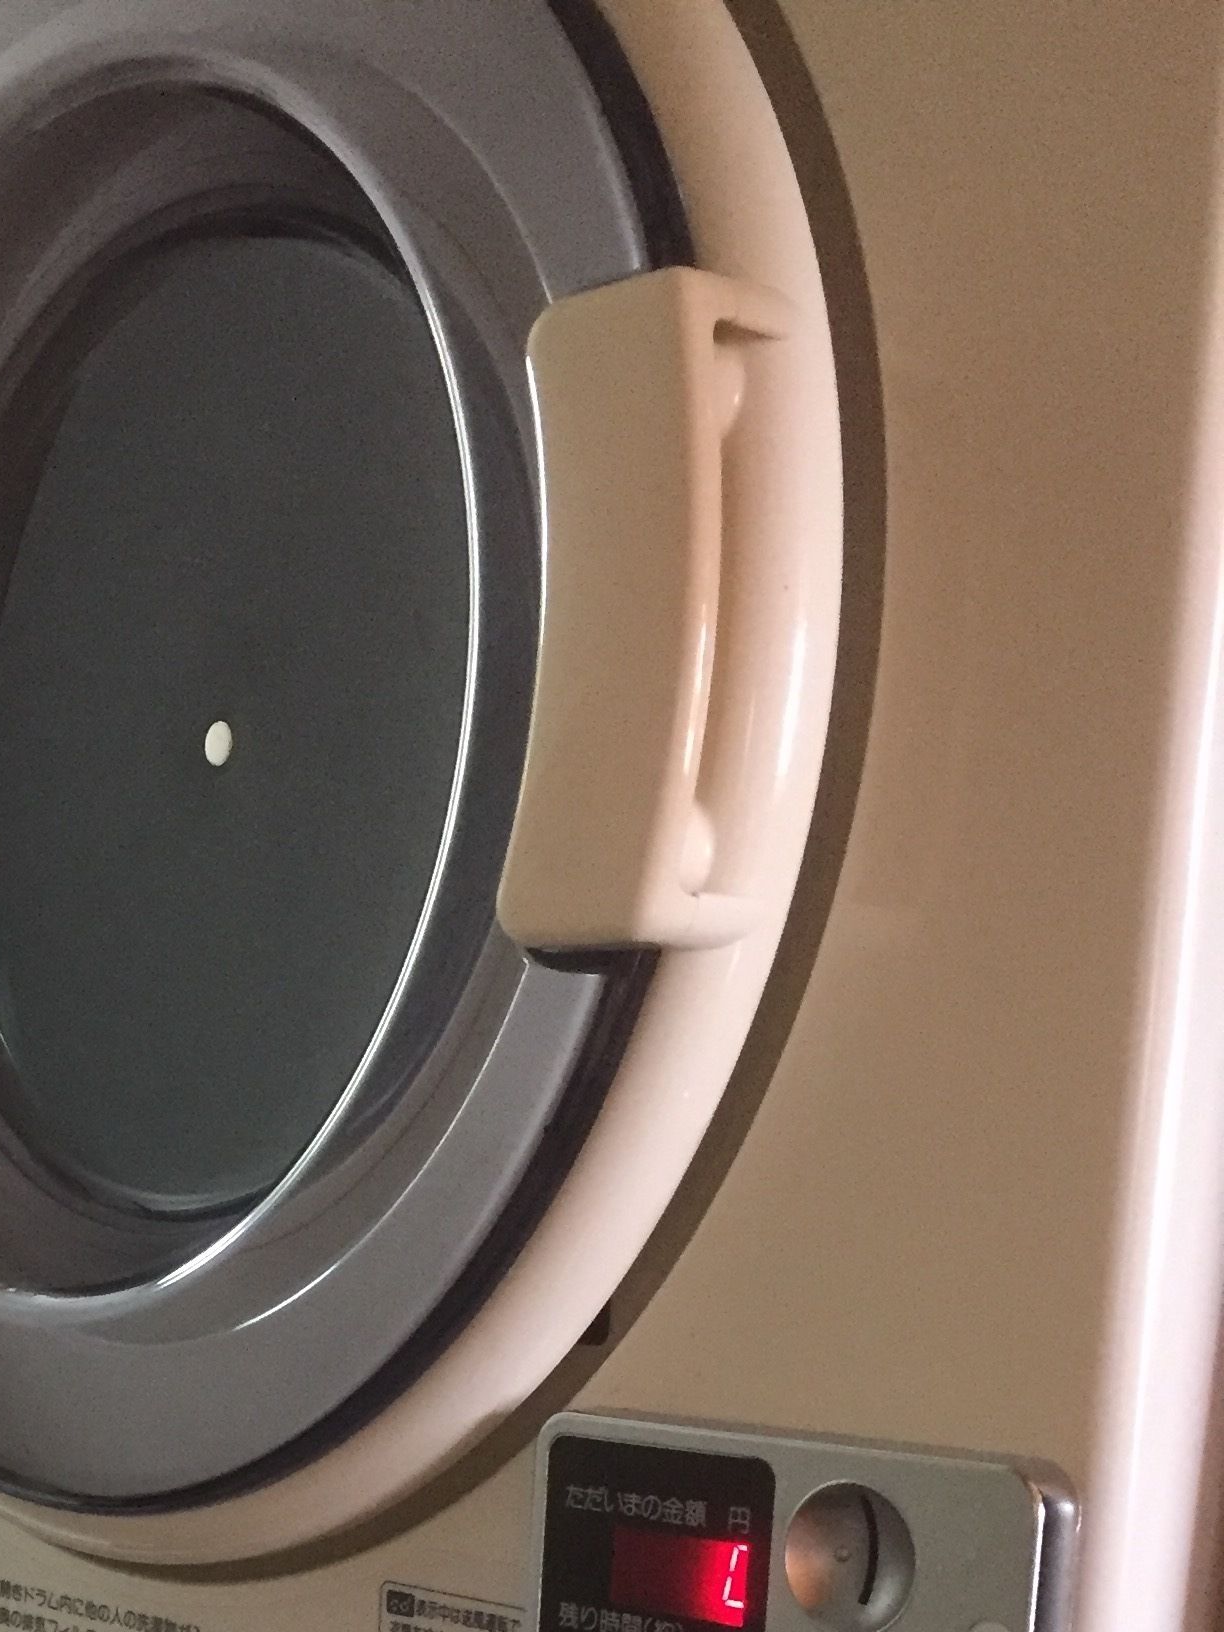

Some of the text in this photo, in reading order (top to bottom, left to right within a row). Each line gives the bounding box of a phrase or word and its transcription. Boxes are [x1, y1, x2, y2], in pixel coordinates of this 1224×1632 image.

[565, 1484, 752, 1534] ただいまの金額 円
